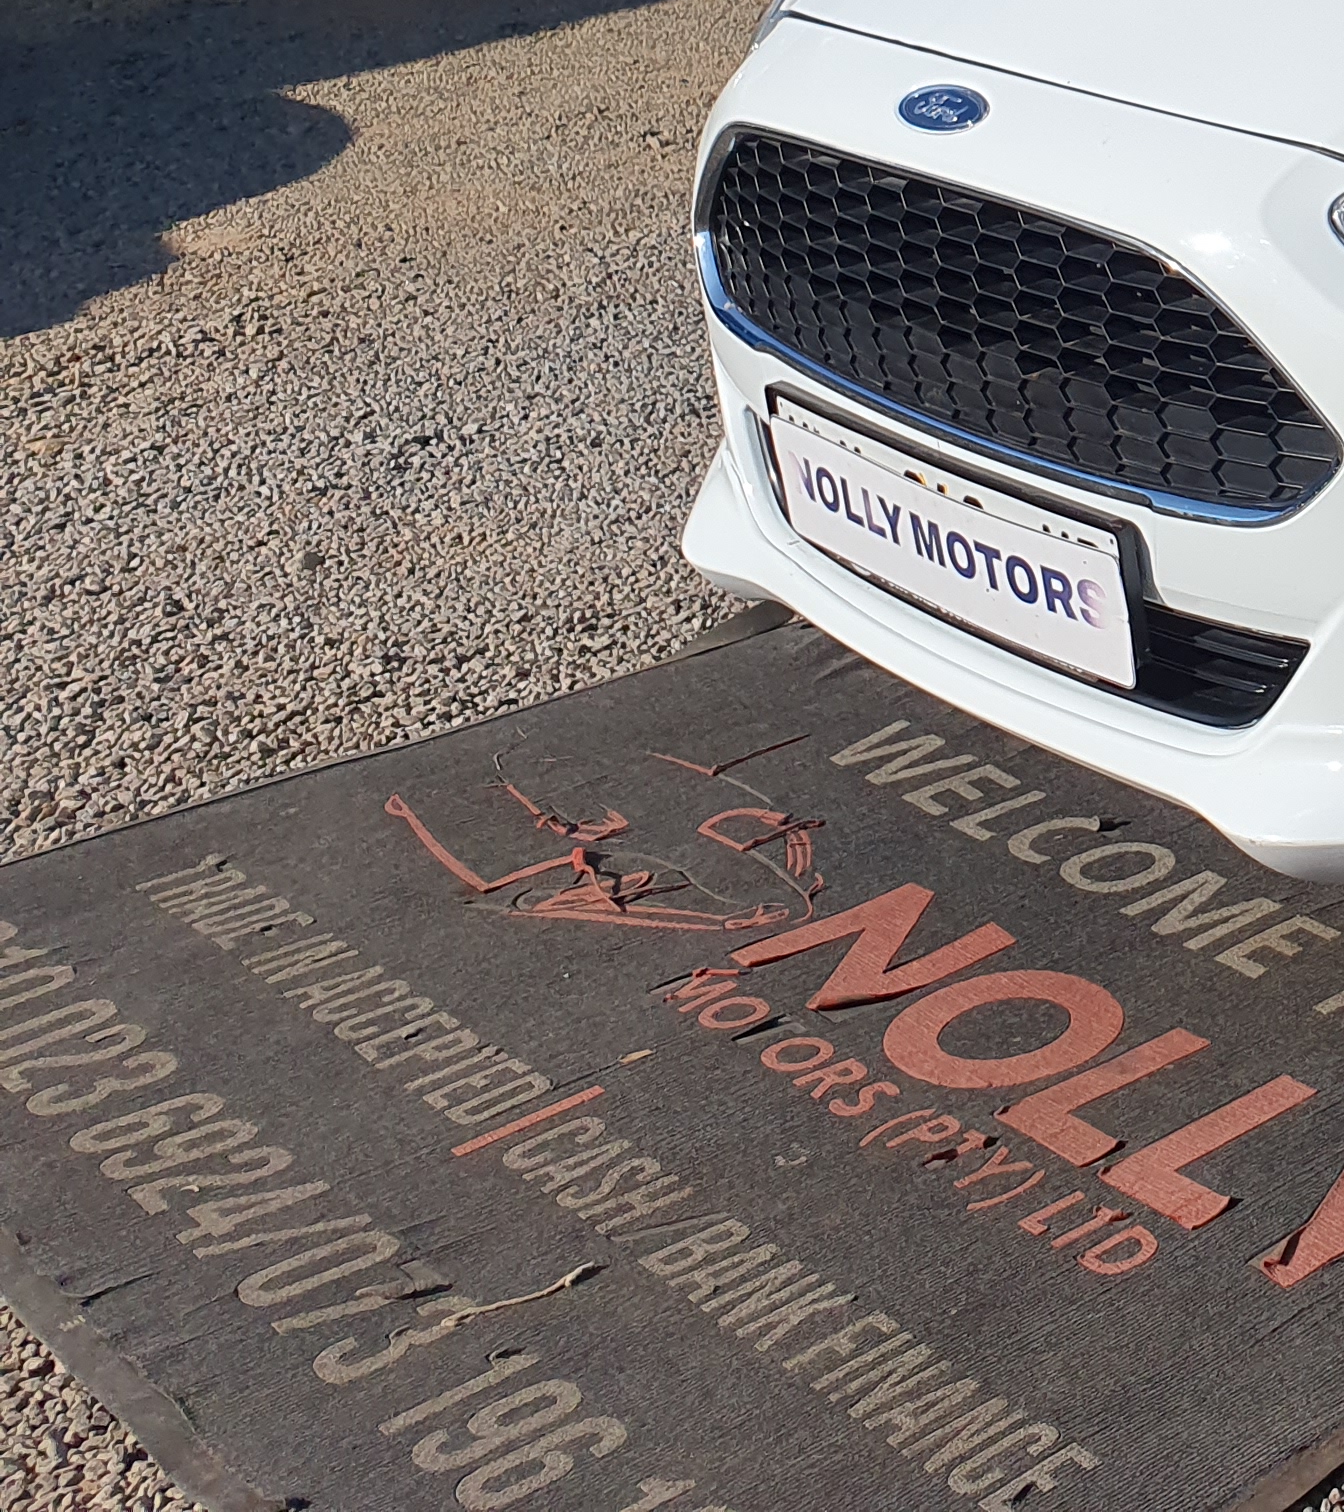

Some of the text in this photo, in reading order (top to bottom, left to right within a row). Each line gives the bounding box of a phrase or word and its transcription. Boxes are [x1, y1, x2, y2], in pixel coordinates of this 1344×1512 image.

[788, 451, 1109, 630] NOLLY MOTORS
[135, 852, 315, 951] TRADE
[830, 719, 1341, 979] WELCOME
[242, 932, 360, 984] IN
[281, 964, 556, 1126] ACCEPTED
[1017, 1190, 1159, 1275] LTD
[378, 1353, 627, 1511] 196
[781, 1309, 1101, 1512] FINANCE
